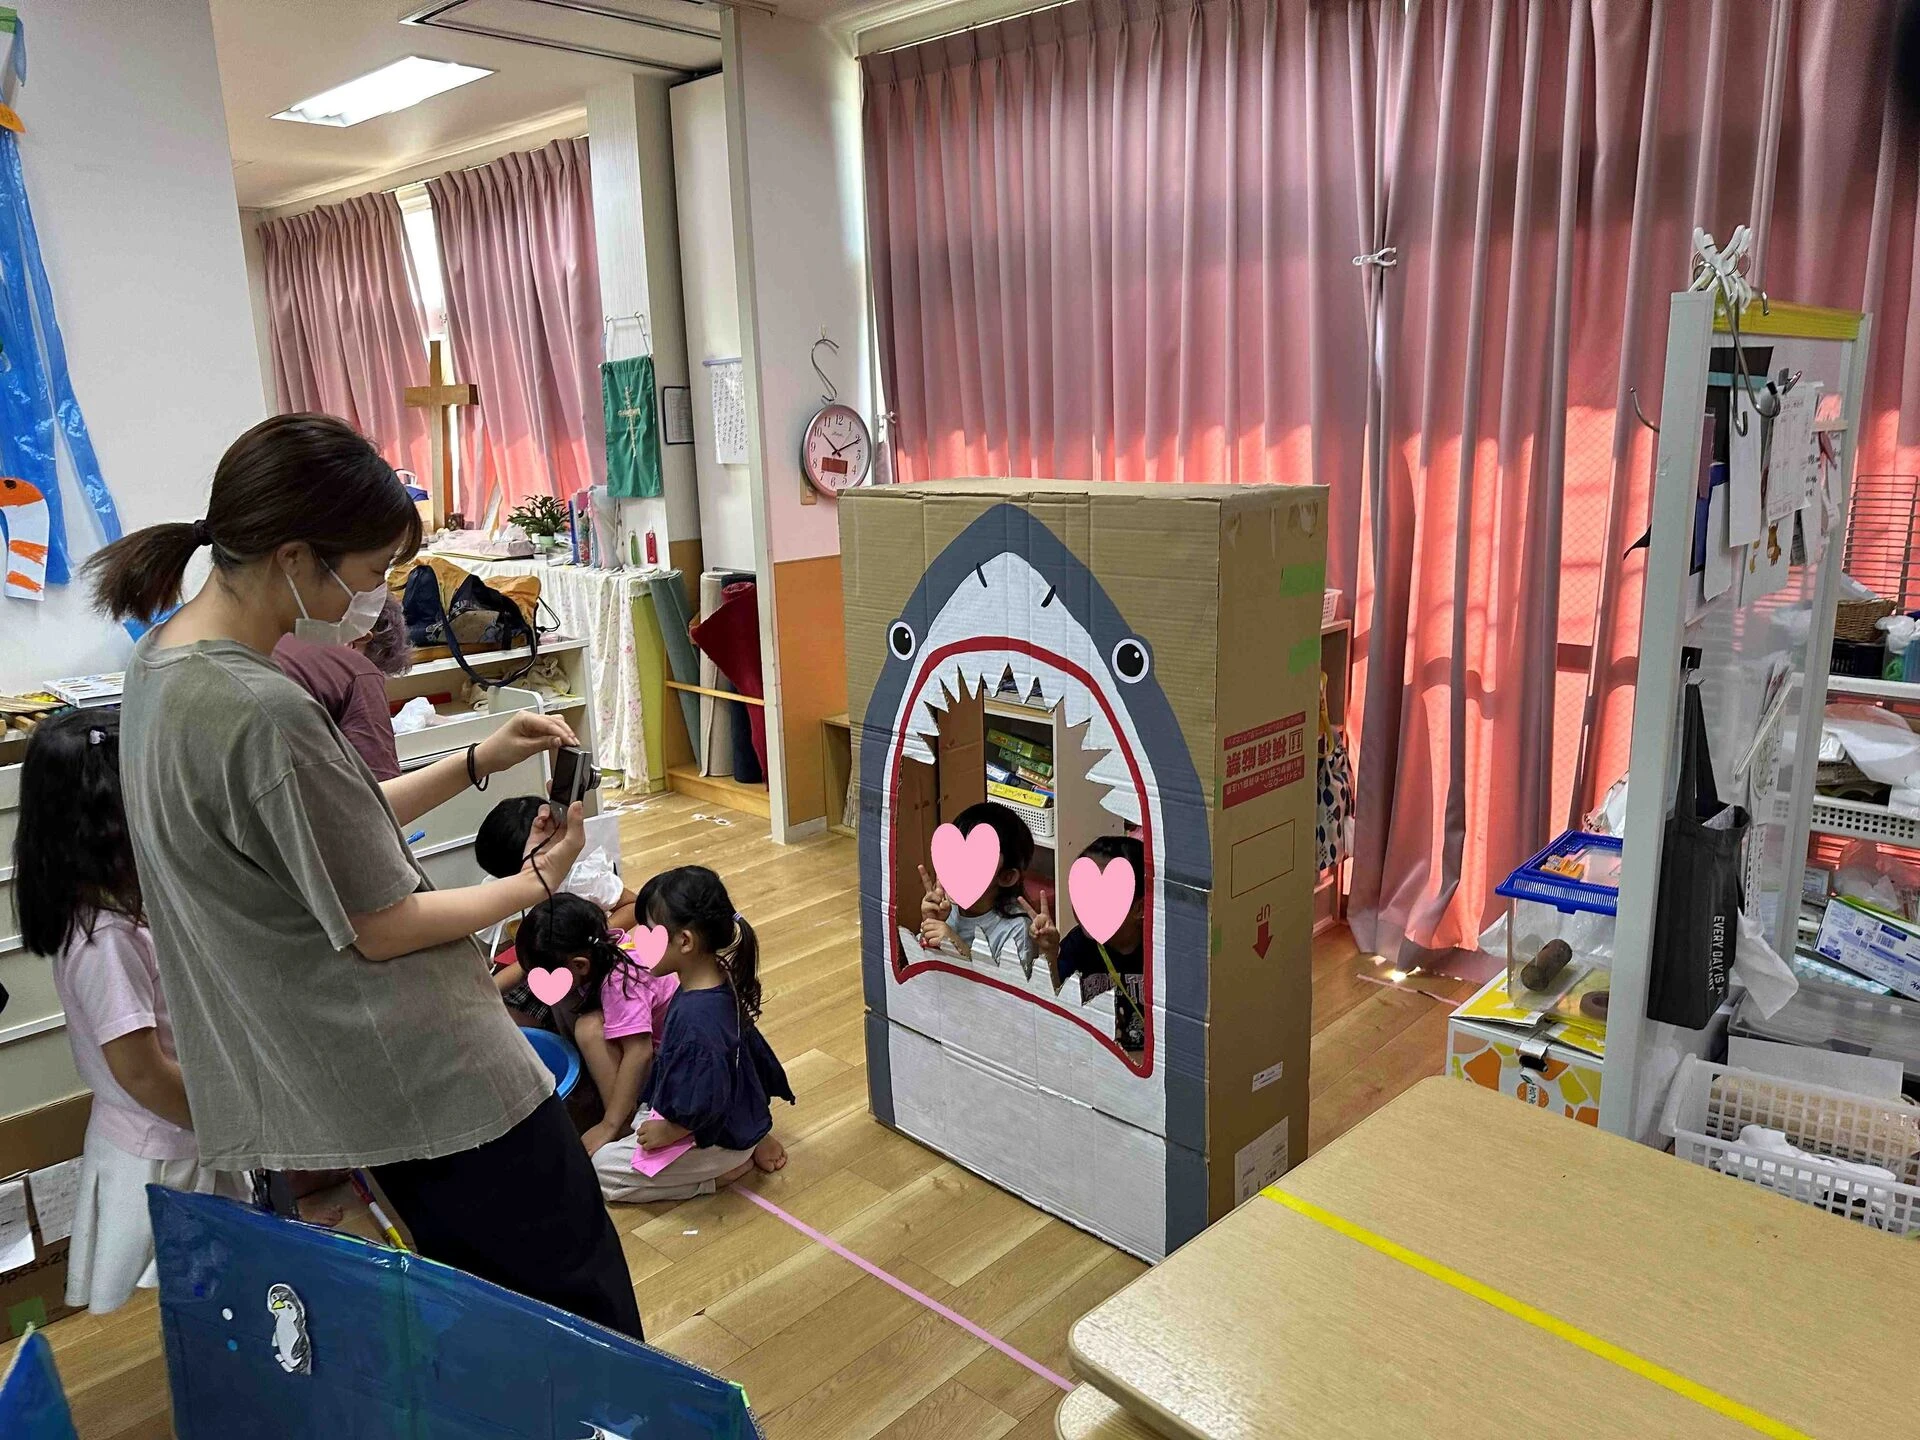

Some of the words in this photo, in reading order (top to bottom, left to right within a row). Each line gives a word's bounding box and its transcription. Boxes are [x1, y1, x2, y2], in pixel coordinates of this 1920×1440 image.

[824, 417, 831, 428] 11
[835, 414, 844, 426] 12
[814, 427, 822, 438] 10
[810, 442, 816, 452] 9
[855, 450, 861, 460] 3
[812, 459, 818, 468] 8
[852, 465, 856, 474] 4
[819, 470, 825, 481] 7
[842, 475, 847, 484] 5
[830, 477, 836, 486] 6
[1256, 903, 1271, 923] UP
[1712, 915, 1725, 949] EVERY
[1711, 950, 1724, 972] DAY
[1713, 973, 1725, 984] IS
